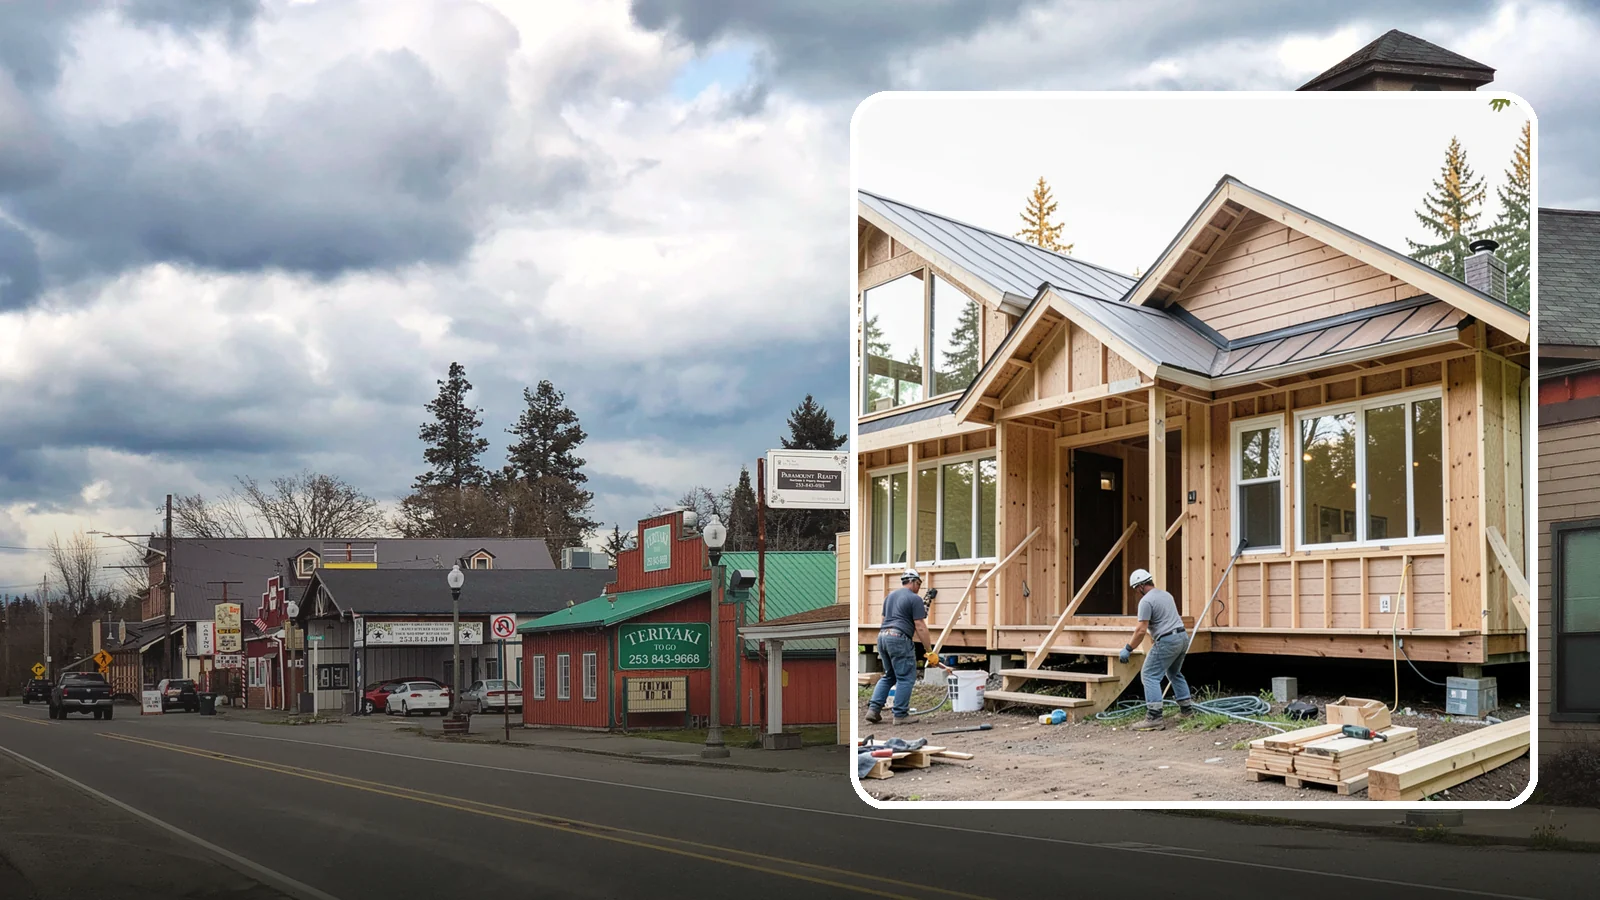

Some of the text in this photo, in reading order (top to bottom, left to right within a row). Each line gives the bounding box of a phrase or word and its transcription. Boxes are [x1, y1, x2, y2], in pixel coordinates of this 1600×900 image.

[625, 628, 702, 645] TERIYAKI
[629, 654, 700, 664] 253 843-9668
